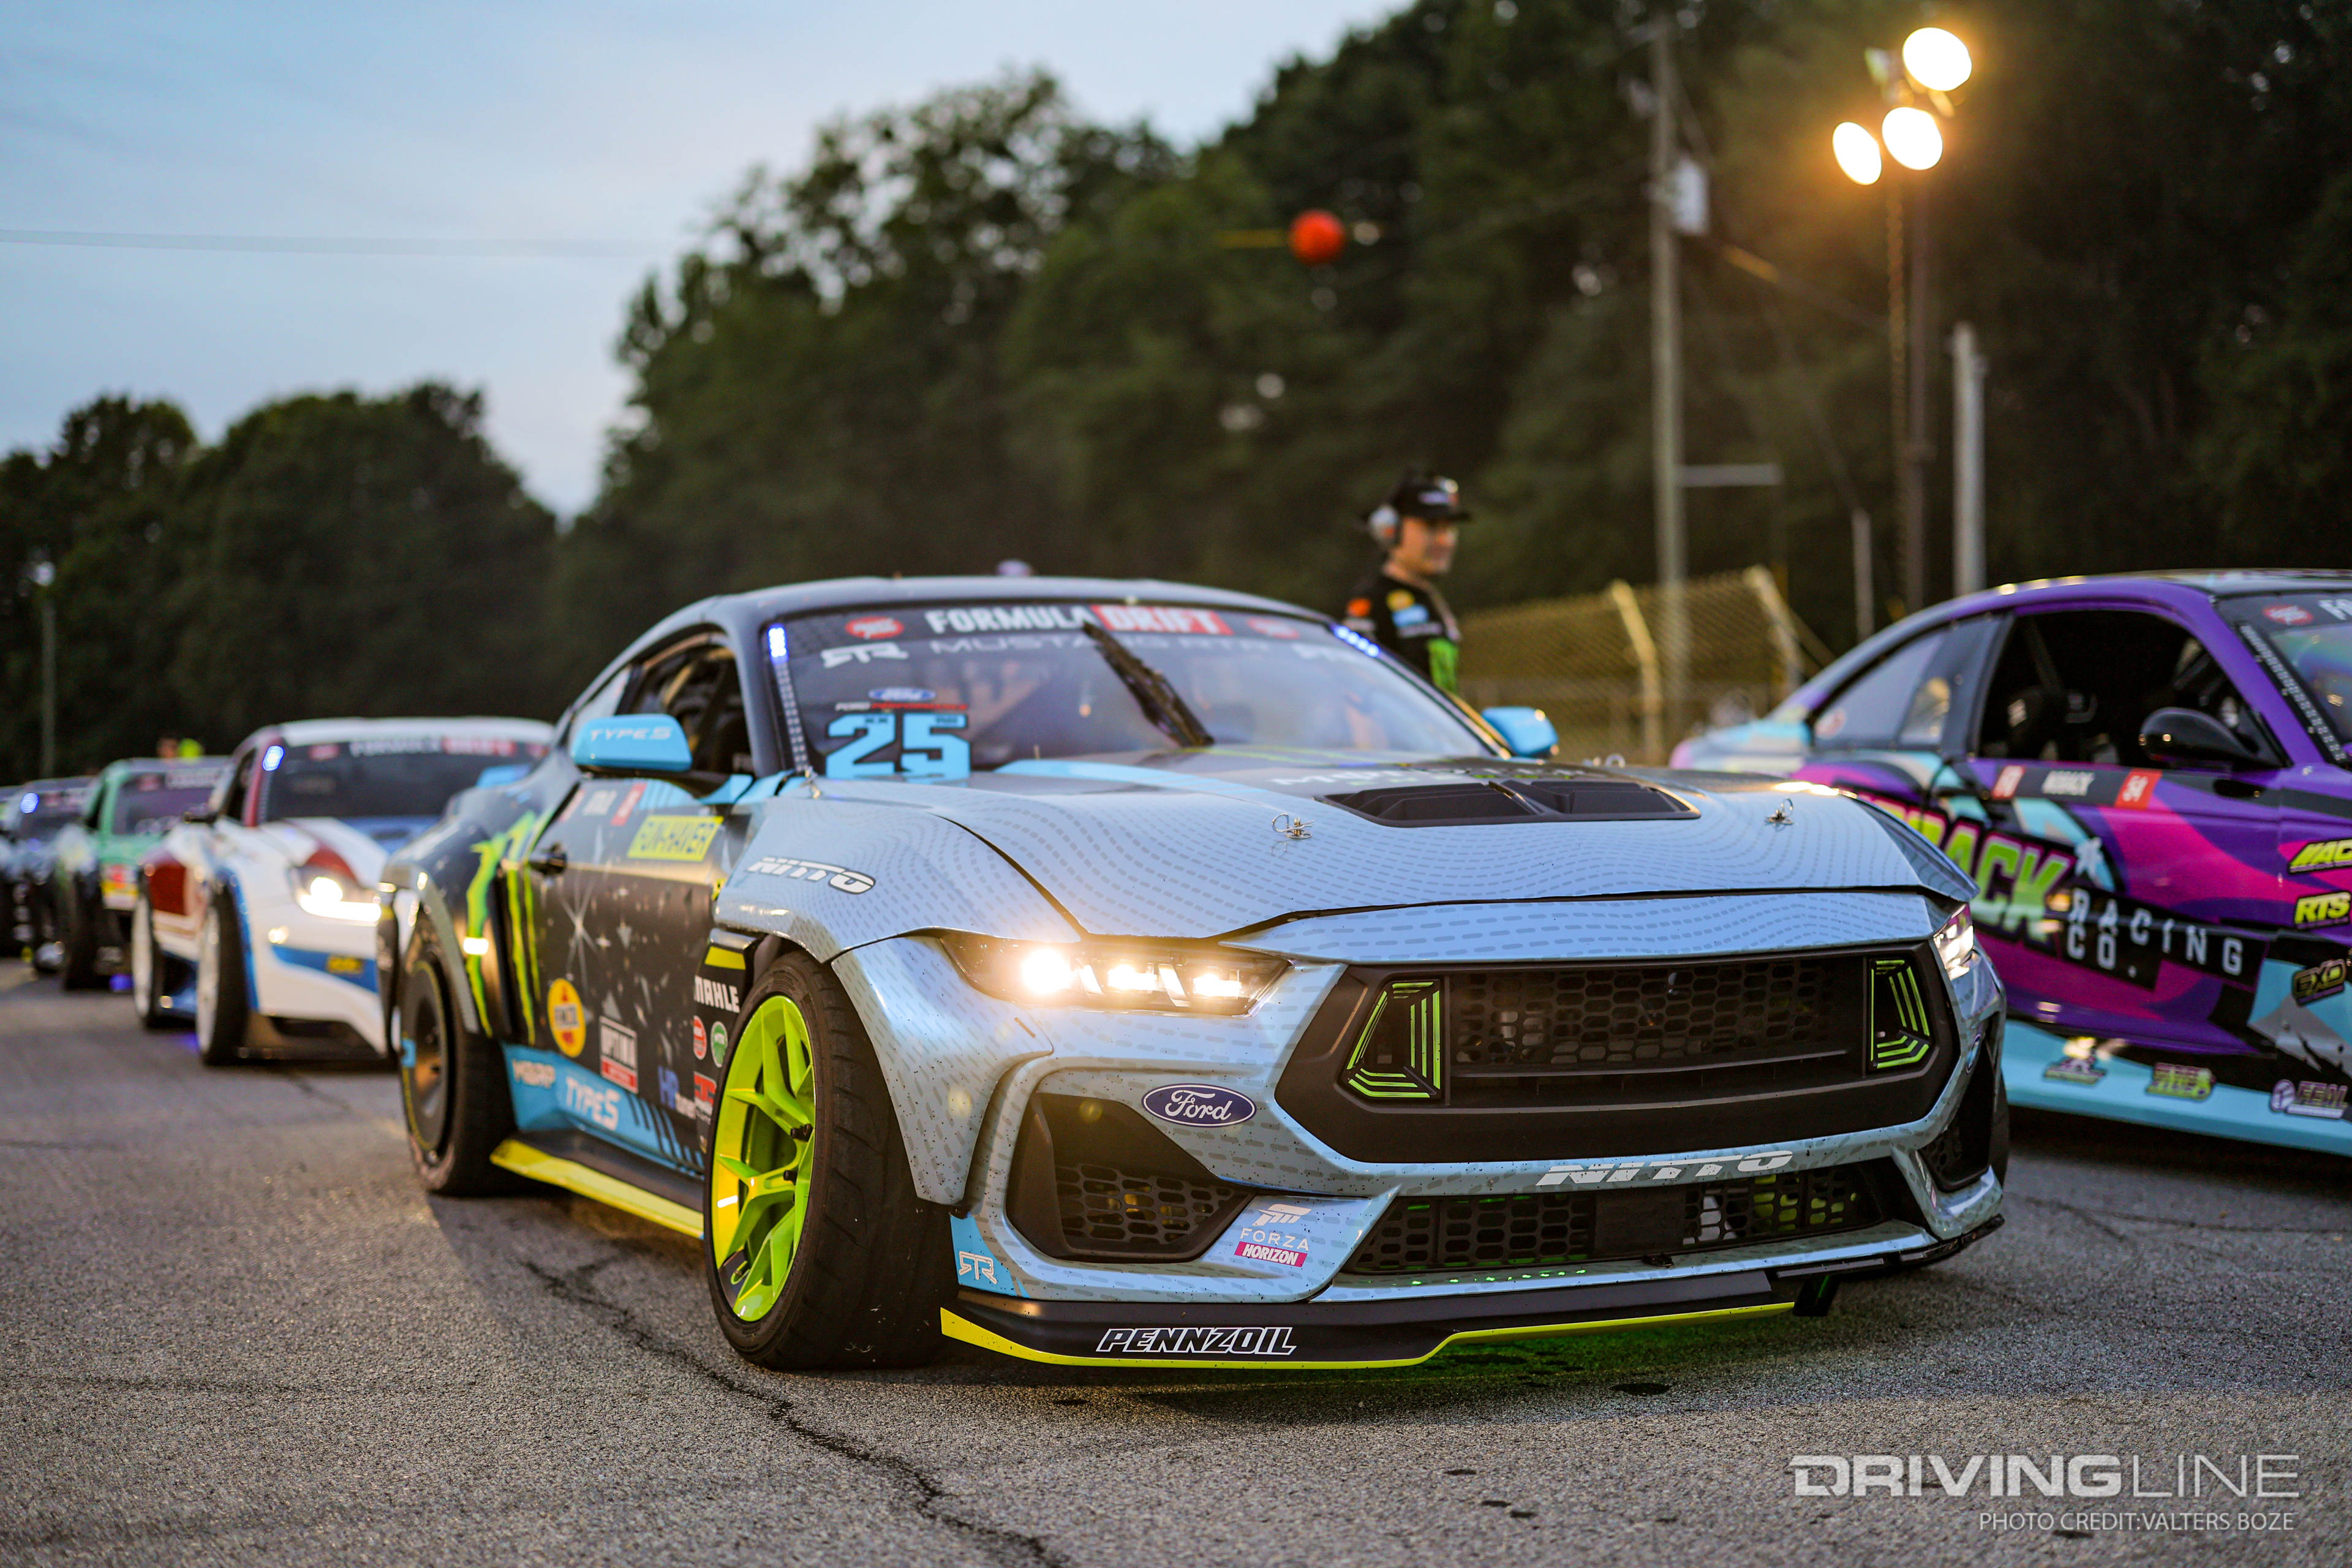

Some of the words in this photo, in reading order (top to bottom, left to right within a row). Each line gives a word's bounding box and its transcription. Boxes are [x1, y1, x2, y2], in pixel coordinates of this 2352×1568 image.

[924, 605, 1098, 633] FORMULA
[1102, 605, 1224, 634] DRIFT
[826, 714, 970, 779] 25
[745, 856, 876, 894] NITTO
[2068, 888, 2244, 976] RACING
[2066, 925, 2137, 978] CO.
[693, 975, 740, 1013] MAHLE
[1165, 1090, 1233, 1120] Ford
[1536, 1150, 1793, 1186] NITTO
[1240, 1227, 1309, 1251] FORZA
[1242, 1243, 1299, 1265] HORIZON
[1095, 1327, 1297, 1355] PENNZOIL
